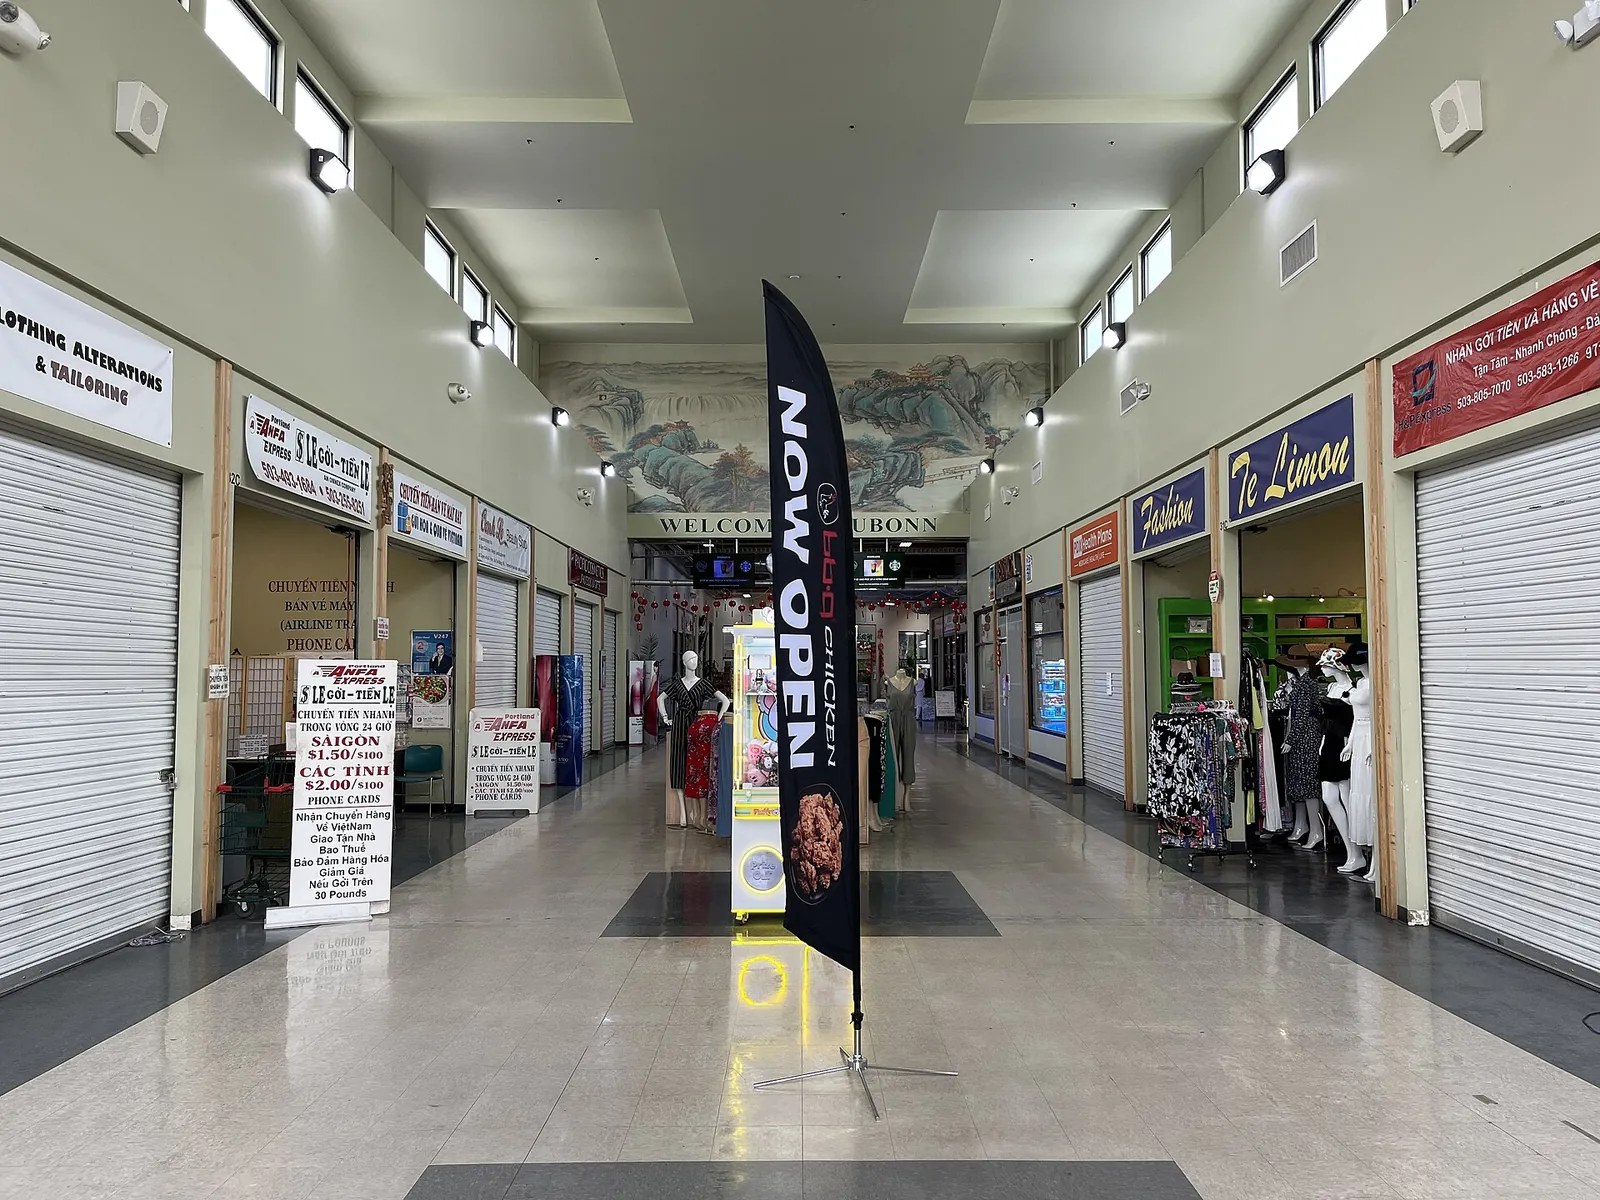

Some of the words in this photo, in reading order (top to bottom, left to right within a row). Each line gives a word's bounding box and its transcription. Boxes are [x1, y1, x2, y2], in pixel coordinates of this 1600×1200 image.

[1523, 308, 1539, 330] VÀ
[1542, 292, 1579, 321] HÀNG
[1515, 339, 1544, 361] Nhanh
[1546, 325, 1578, 347] Chóng
[72, 341, 163, 393] ALTERATIONS
[35, 355, 47, 375] &
[50, 360, 129, 406] TAILORING
[1457, 380, 1511, 410] 503-805-7070
[1517, 352, 1579, 387] 503-583-1266
[259, 417, 285, 444] ANFA
[263, 440, 292, 462] EXPRESS
[777, 385, 810, 565] NOW
[1231, 451, 1258, 515] Te
[1264, 432, 1350, 502] Limon
[1141, 484, 1194, 549] Fashion
[660, 517, 772, 533] WELCOM
[852, 517, 939, 533] UBONN
[285, 597, 309, 611] BÁN
[311, 597, 327, 611] VÉ
[280, 619, 333, 632] (AIRLINE
[287, 638, 332, 651] PHONE
[328, 665, 378, 677] ANFA
[779, 578, 816, 770] OPEN
[333, 677, 386, 685] EXPRESS
[823, 625, 837, 767] CHICKEN
[363, 710, 395, 719] NHANH
[300, 722, 332, 732] TRONG
[362, 723, 372, 732] 24
[488, 717, 528, 731] ANFA
[493, 732, 536, 742] EXPRESS
[308, 795, 344, 806] PHONE
[347, 794, 381, 804] CARDS
[475, 793, 498, 801] PHONE
[500, 793, 522, 801] CARDS
[366, 811, 391, 821] Hàng
[310, 834, 334, 844] Giao
[356, 832, 376, 842] Nhà
[319, 845, 339, 855] Bao
[342, 856, 368, 866] Hàng
[370, 854, 390, 863] Hóa
[348, 866, 365, 876] Giá
[352, 877, 374, 887] Trên
[314, 891, 327, 900] 30
[329, 889, 367, 899] Pounds
